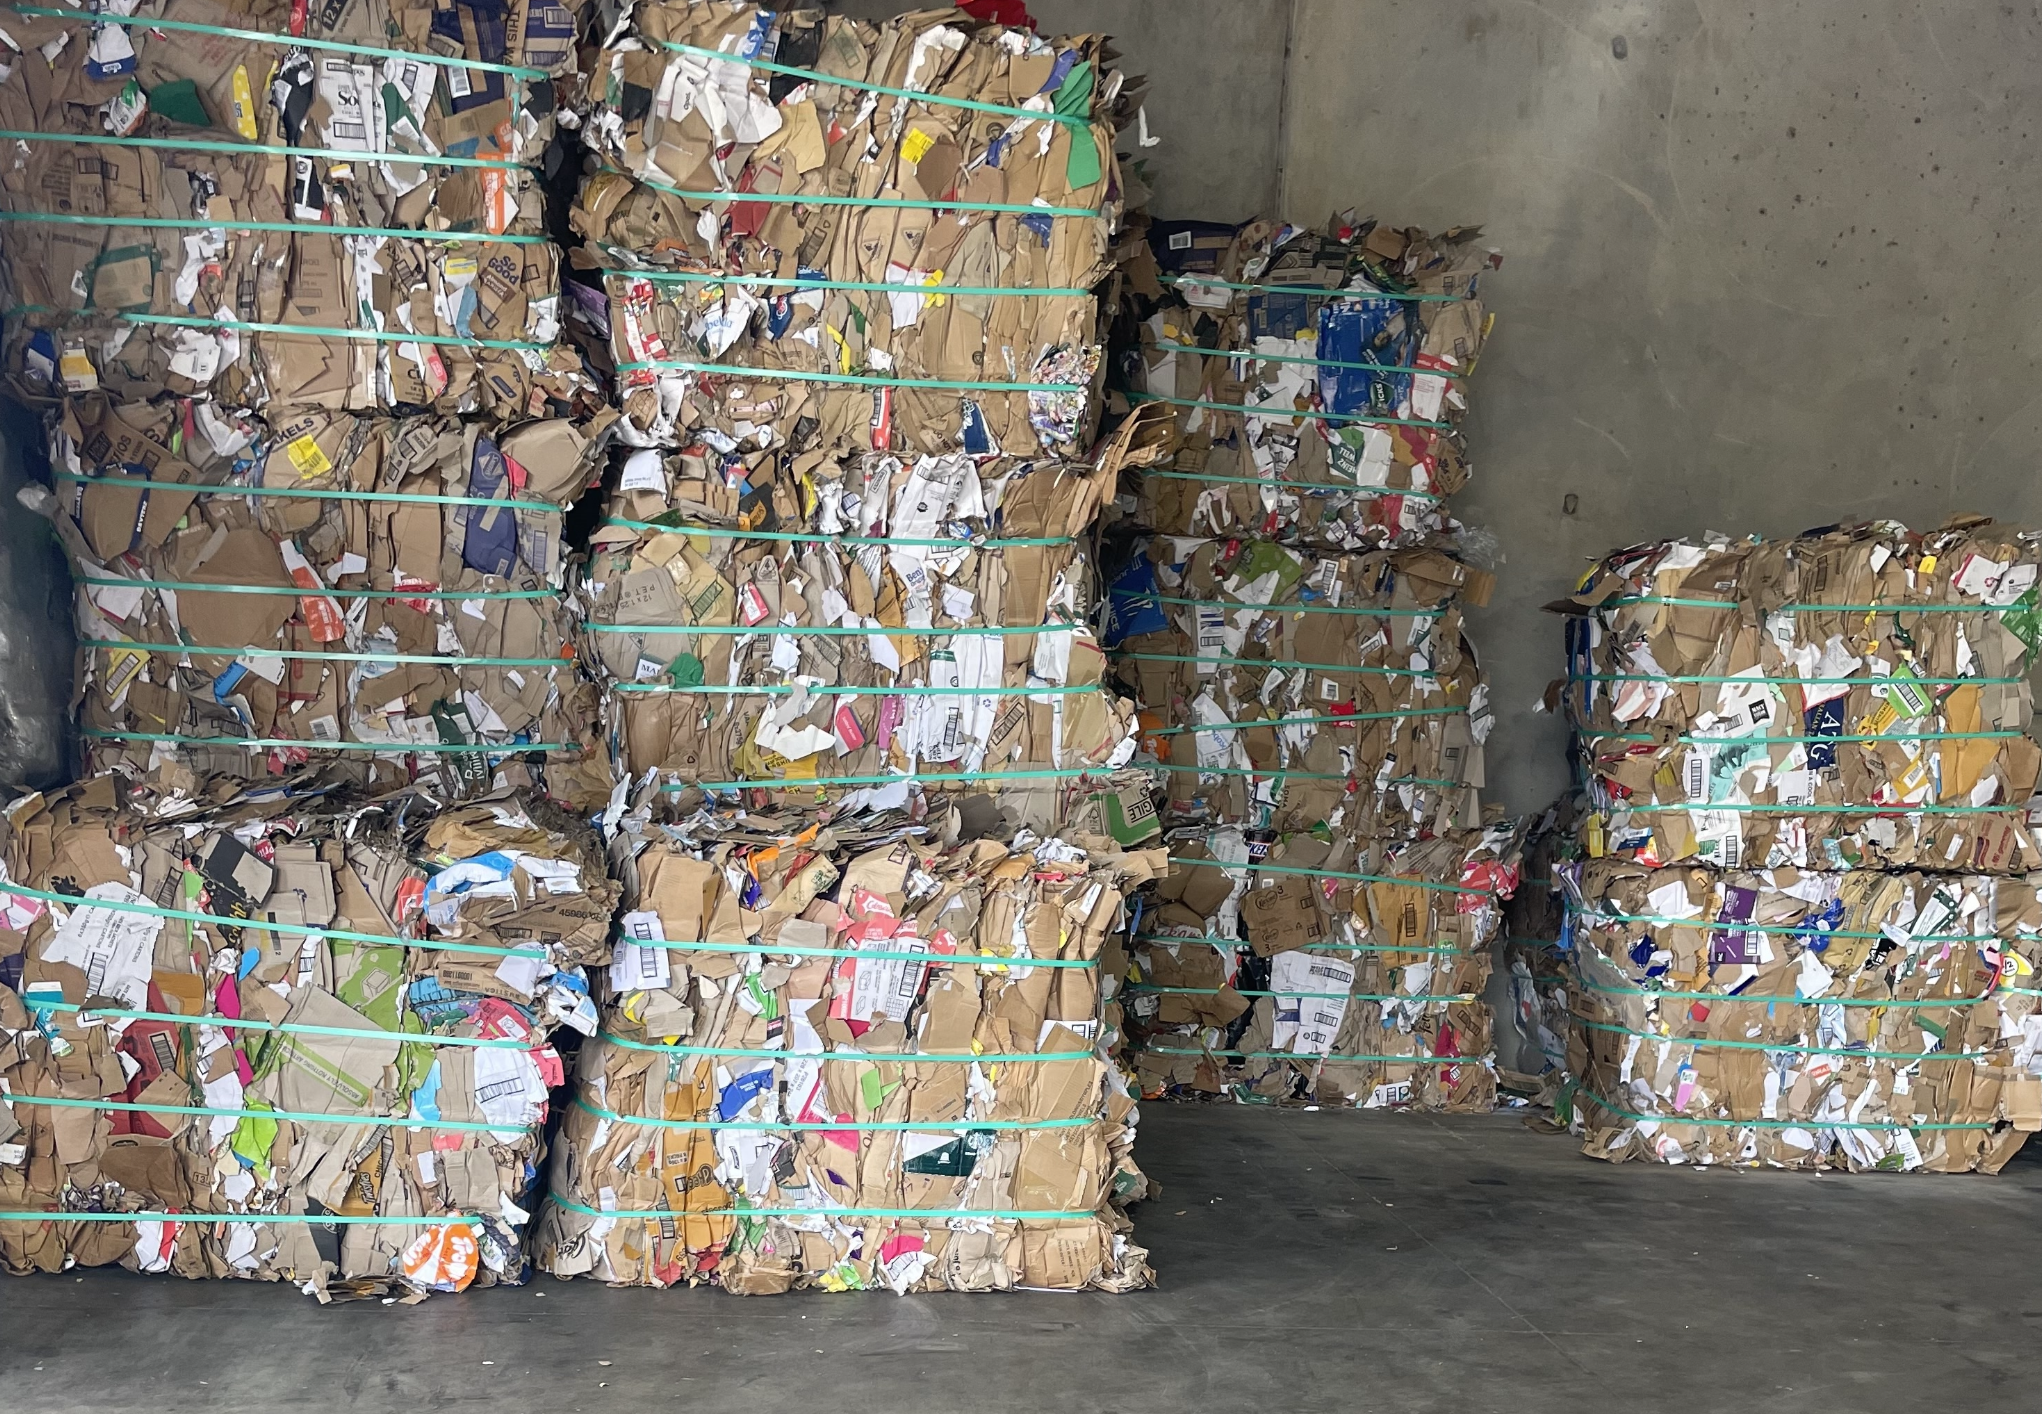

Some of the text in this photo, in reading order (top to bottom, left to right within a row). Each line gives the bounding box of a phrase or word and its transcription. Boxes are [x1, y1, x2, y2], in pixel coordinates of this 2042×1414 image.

[321, 9, 337, 30] 12
[509, 9, 521, 43] THIS
[1337, 446, 1357, 461] WELL
[1335, 456, 1358, 474] HEINZ
[1129, 799, 1153, 822] GILE
